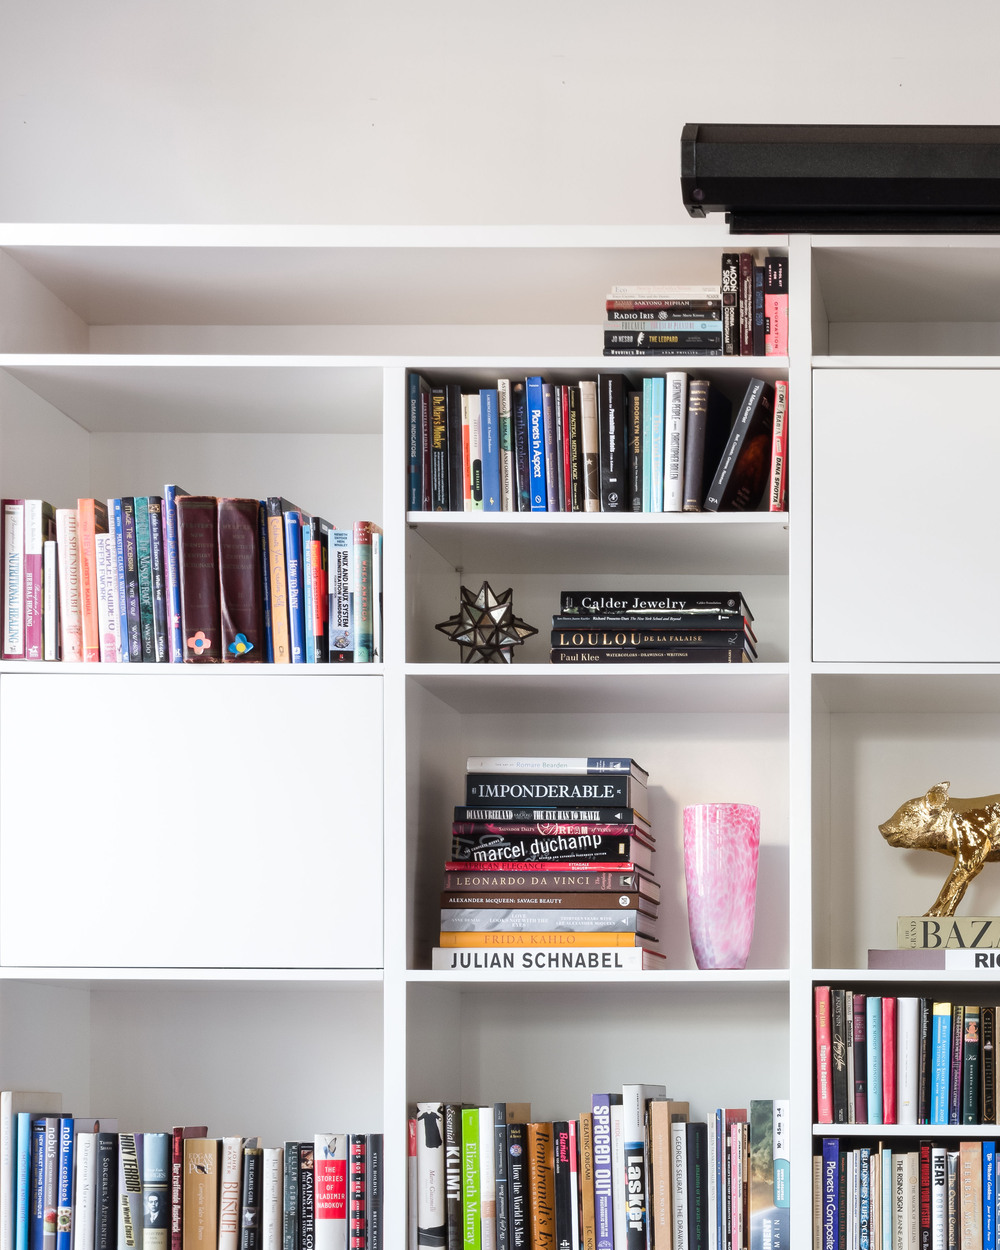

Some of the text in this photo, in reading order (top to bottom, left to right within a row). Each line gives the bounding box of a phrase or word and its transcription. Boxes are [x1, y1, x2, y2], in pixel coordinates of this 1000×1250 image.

[531, 409, 543, 478] Planets in Aspect
[8, 552, 20, 643] NUTRITIONAL HEALING
[581, 597, 686, 611] Calder Jewelry
[560, 633, 642, 646] LOULOU
[560, 653, 600, 662] Paul Klee
[478, 784, 614, 799] IMPONDERABLE
[473, 834, 602, 862] marcel duchamp
[456, 877, 591, 886] LEONARDO DA VINCI
[484, 935, 576, 945] FRIDA KAHLO
[451, 952, 623, 969] JULIAN SCHNABEL
[446, 1105, 460, 1201] Essential KLIMT
[559, 1132, 569, 1162] Buñuel
[675, 1136, 683, 1169] GEORGES
[120, 1134, 141, 1193] HOLY TERROR
[513, 1164, 522, 1181] How
[896, 1160, 904, 1172] THE
[934, 1155, 945, 1187] HEAR
[316, 1175, 344, 1183] STORIES
[513, 1182, 521, 1195] the
[535, 1131, 553, 1226] Rembrandt's
[921, 1147, 930, 1228] DON'T MURDER YOUR MYSTERY
[172, 1163, 181, 1233] Der treffende Ausdruck
[221, 1181, 239, 1234] BUÑUEL
[464, 1143, 478, 1245] Elizabeth Murray
[514, 1196, 522, 1218] World
[628, 1155, 646, 1232] Lasker
[824, 1161, 836, 1250] Planets in Composite
[514, 1227, 523, 1247] Made
